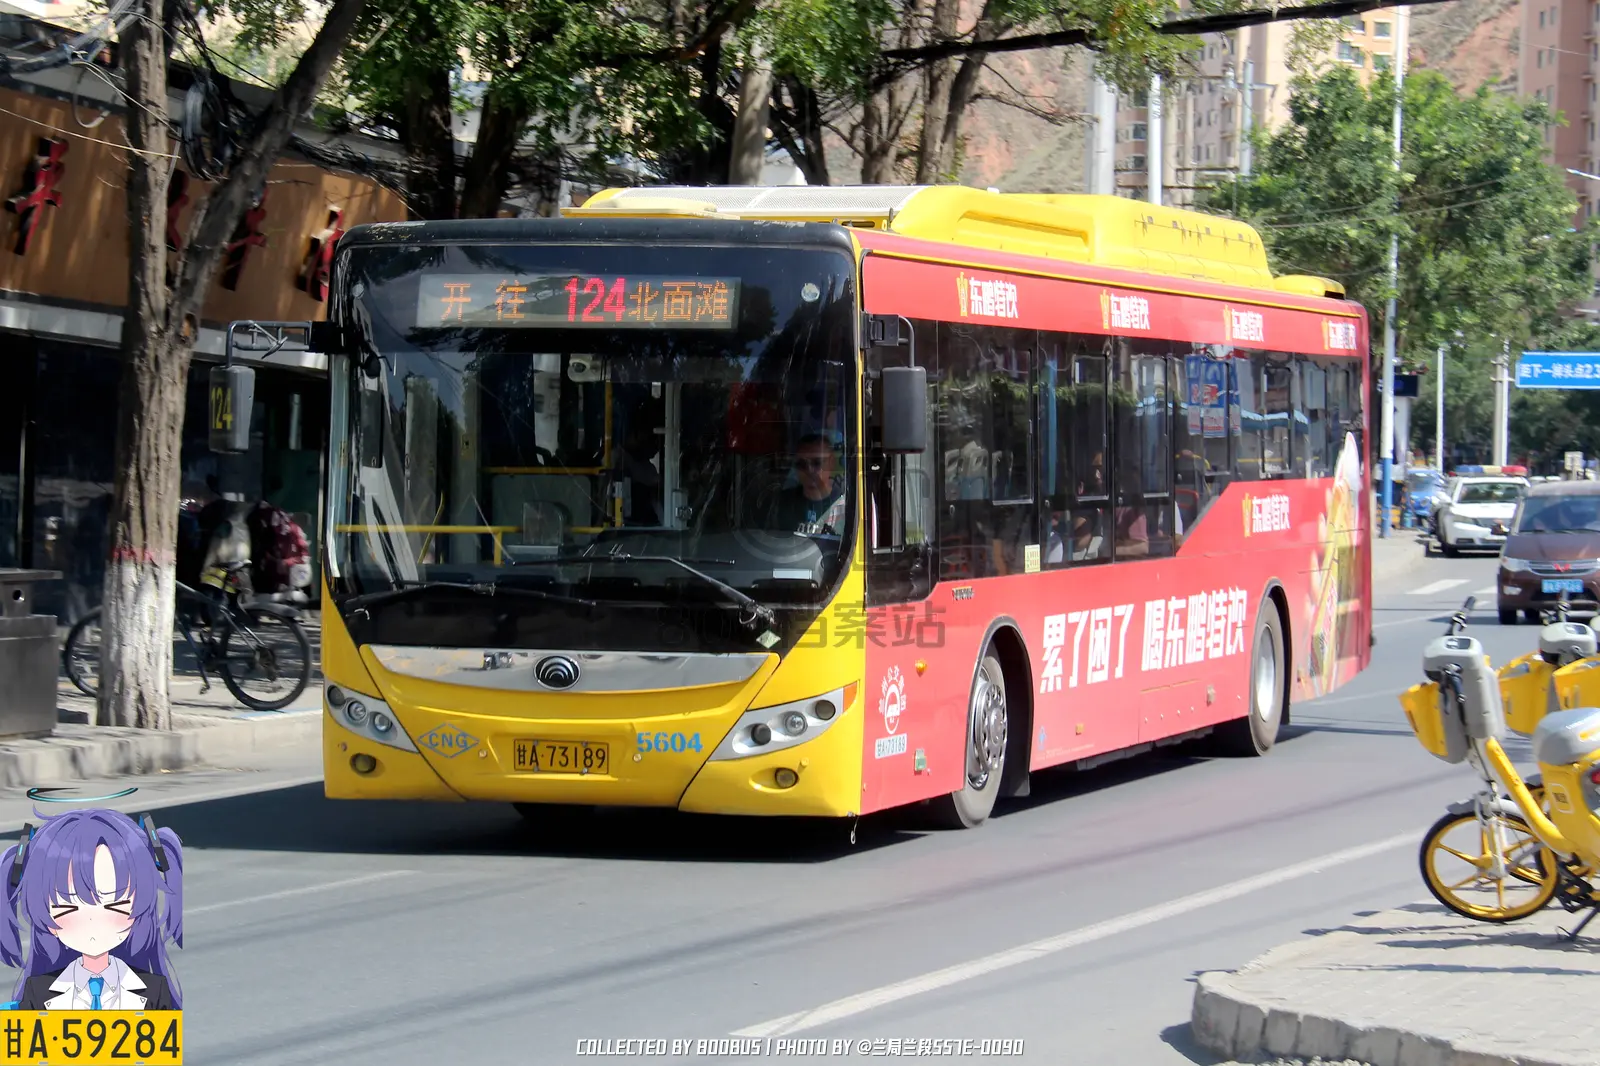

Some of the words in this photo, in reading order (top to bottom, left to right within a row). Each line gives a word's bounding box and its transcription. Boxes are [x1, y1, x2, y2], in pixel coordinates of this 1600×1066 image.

[564, 277, 627, 322] 124
[628, 280, 729, 321] 北面滩
[969, 277, 1019, 319] 东鹏特饮
[1110, 293, 1151, 330] 东鹏特饮
[210, 387, 233, 431] 124
[1252, 493, 1291, 533] 东鹏特饮
[1040, 604, 1134, 694] 累了困了
[1141, 587, 1248, 672] 喝东鹏特饮
[428, 732, 469, 749] CNG
[636, 731, 703, 753] 5604
